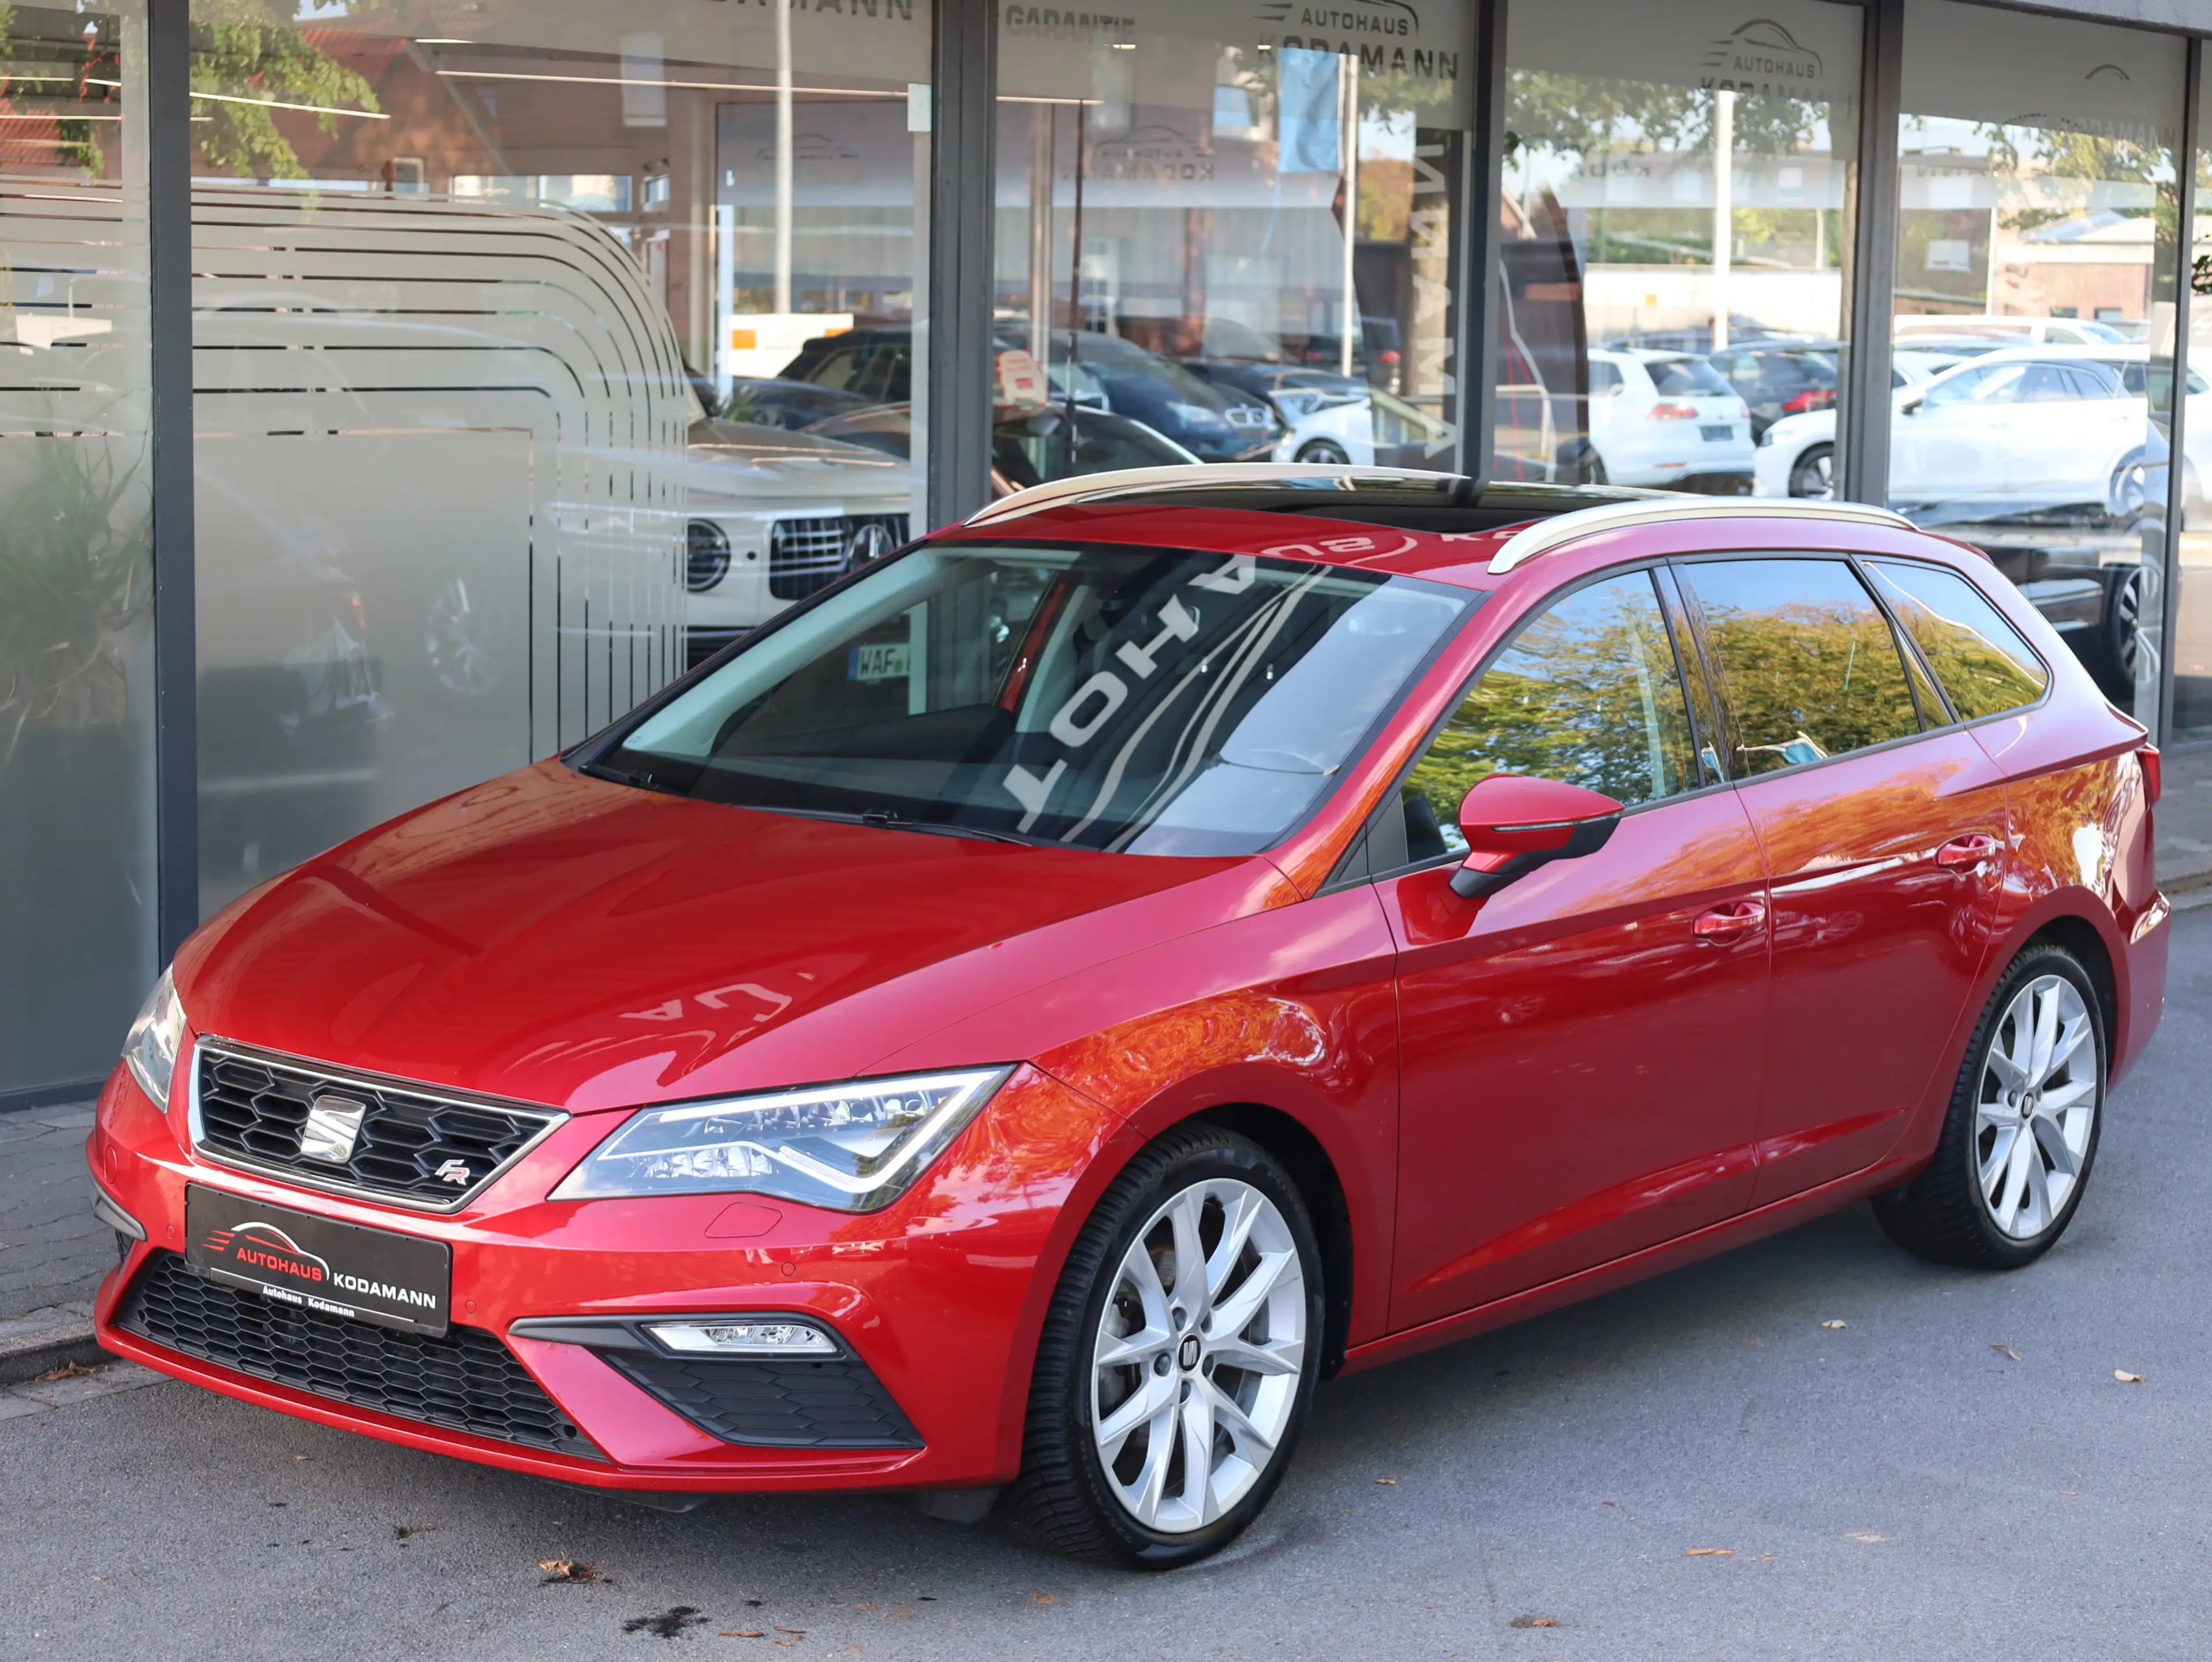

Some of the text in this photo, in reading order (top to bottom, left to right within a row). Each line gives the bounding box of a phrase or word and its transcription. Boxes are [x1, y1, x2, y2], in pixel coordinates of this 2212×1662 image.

[1301, 8, 1408, 36] AUTOHAUS
[1733, 55, 1815, 79] AUTOHAUS
[435, 1159, 470, 1186] FR
[236, 1247, 437, 1309] AUTOHAUS KODAMANN
[263, 1285, 355, 1318] Autohaus Kodamann
